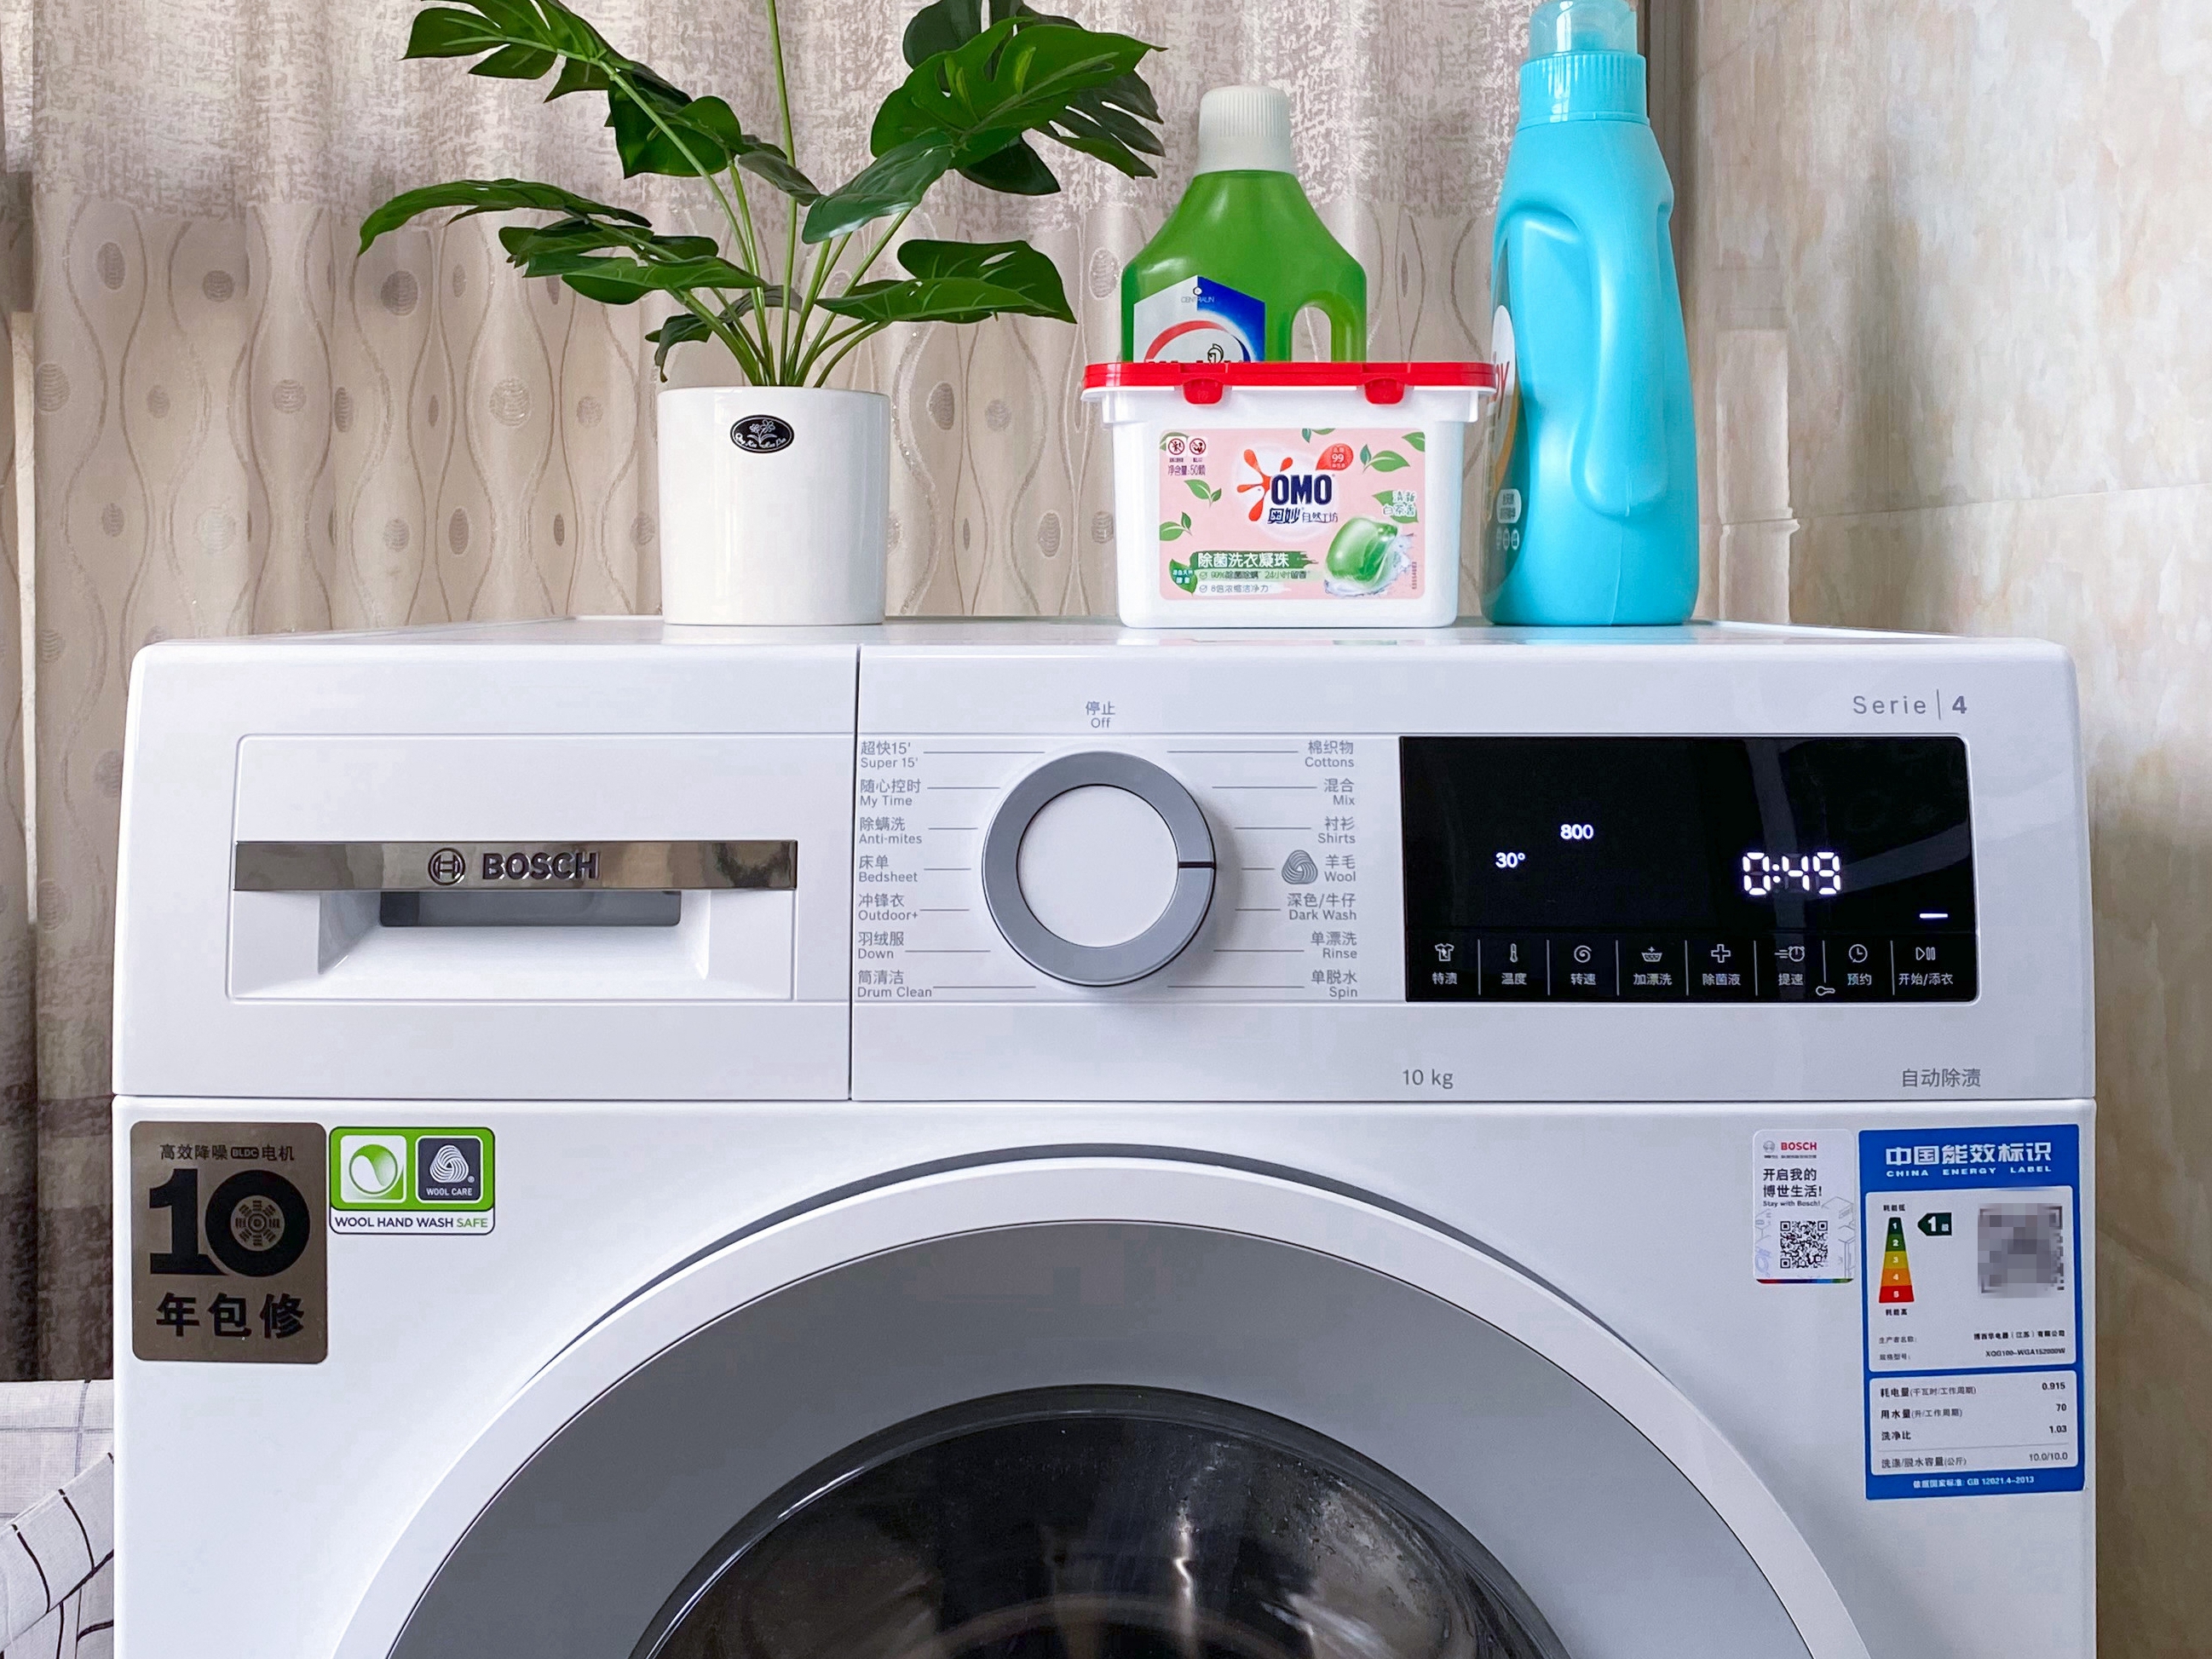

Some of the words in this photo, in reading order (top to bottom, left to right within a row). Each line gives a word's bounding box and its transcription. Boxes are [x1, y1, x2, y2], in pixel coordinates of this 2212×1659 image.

[1331, 453, 1345, 463] 99
[1270, 474, 1333, 506] OMO
[1197, 551, 1290, 568] 除菌洗衣凝珠
[1086, 700, 1115, 716] 停止
[1852, 694, 1927, 714] Serie
[1091, 717, 1111, 729] Off
[861, 740, 911, 756] 超快15'
[1308, 740, 1355, 755] 棉织物
[861, 757, 898, 770] Super
[902, 757, 918, 769] 15'
[1305, 756, 1355, 768] Cottons
[860, 778, 921, 793] 随心控时
[1324, 777, 1355, 793] 混合
[860, 795, 878, 808] My
[882, 795, 913, 806] Time
[1334, 794, 1356, 805] Mix
[860, 816, 906, 832] 除螨洗
[1324, 815, 1356, 832] 衬衫
[859, 833, 923, 844] Anti-mites
[1317, 832, 1357, 844] Shirts
[1559, 824, 1594, 840] 800
[481, 852, 600, 880] BOSCH
[859, 855, 889, 870] 床单
[1325, 854, 1357, 870] 羊毛
[1495, 851, 1526, 868] 30°
[858, 871, 919, 883] Bedsheet
[1323, 870, 1357, 883] Wool
[1743, 852, 1841, 896] 0:49
[858, 893, 905, 908] 冲锋衣
[1287, 892, 1357, 908] 深色/牛仔
[858, 909, 919, 921] Outdoor+
[1288, 908, 1319, 920] Dark
[1322, 908, 1357, 920] Wash
[857, 931, 905, 947] 羽绒服
[1310, 930, 1357, 947] 单漂洗
[857, 948, 894, 959] Down
[1322, 948, 1358, 959] Rinse
[857, 970, 905, 985] 筒清洁
[1310, 969, 1358, 986] 单脱水
[1501, 972, 1528, 987] 温度
[1570, 972, 1597, 987] 转速
[1633, 972, 1673, 987] 加漂洗
[1777, 972, 1804, 987] 提速
[1847, 972, 1873, 987] 预约
[1898, 972, 1954, 987] 开始/添衣
[857, 987, 891, 998] Drum
[896, 986, 932, 998] Clean
[1328, 986, 1358, 999] Spin
[1403, 1069, 1424, 1086] 10
[1431, 1068, 1454, 1088] kg
[1901, 1068, 1981, 1087] 自动除渍
[159, 1143, 228, 1161] 高效降噪
[231, 1147, 259, 1159] BLDC
[262, 1144, 295, 1161] 电机
[1780, 1142, 1817, 1151] BOSCH
[1886, 1142, 2052, 1166] 中国能效标识
[1763, 1168, 1817, 1181] 开启我的
[1886, 1169, 1929, 1178] CHINA
[1942, 1166, 1997, 1176] ENERGY
[2010, 1165, 2052, 1174] LABEL
[425, 1187, 450, 1197] WOOL
[451, 1187, 474, 1197] CARE
[1763, 1184, 1823, 1198] 博世生活!
[1763, 1200, 1778, 1208] Stay
[149, 1167, 310, 1277] 10
[334, 1217, 375, 1228] WOOL
[376, 1217, 414, 1228] HAND
[416, 1218, 455, 1228] WASH
[457, 1218, 489, 1228] SAFE
[1927, 1216, 1937, 1232] 1
[156, 1293, 305, 1339] 年包修
[2042, 1381, 2065, 1391] 0.915
[2055, 1403, 2066, 1413] 70
[1881, 1431, 1911, 1442] 洗净比
[2048, 1425, 2067, 1435] 1.03
[2028, 1452, 2068, 1463] 10.0/10.0
[1967, 1478, 1980, 1488] GB
[1981, 1476, 2035, 1487] 12021.4-2013
